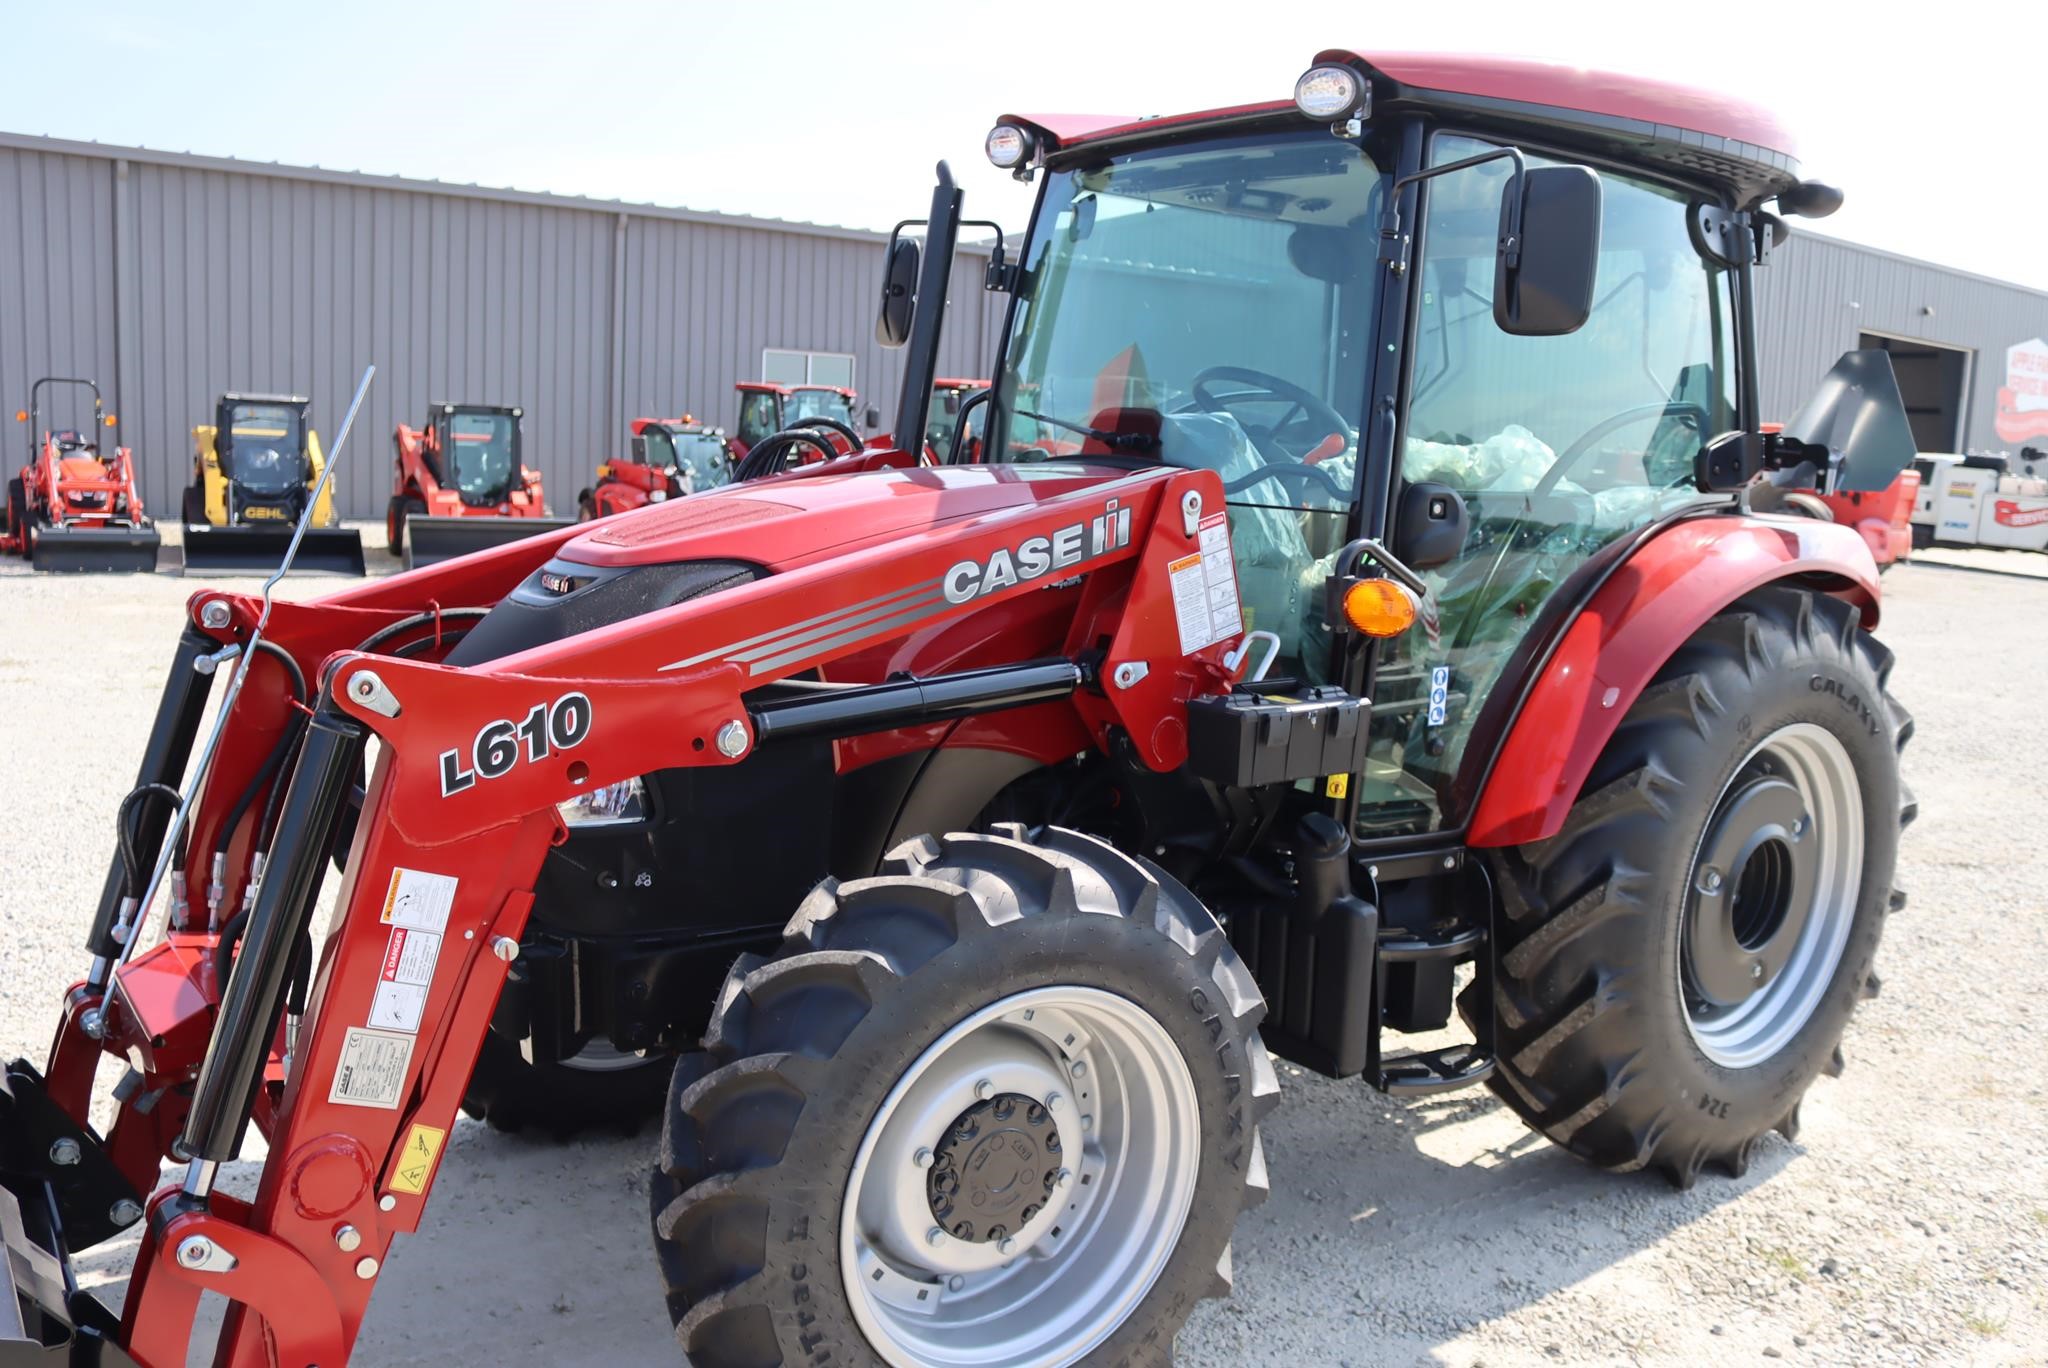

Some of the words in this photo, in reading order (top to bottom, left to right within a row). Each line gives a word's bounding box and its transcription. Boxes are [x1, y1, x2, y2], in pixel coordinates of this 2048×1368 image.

[245, 506, 287, 520] GEHL
[943, 523, 1083, 604] CASE
[542, 574, 560, 591] CASE
[1808, 673, 1881, 736] GALAXY
[439, 691, 592, 798] L610
[388, 871, 402, 908] WARNING
[388, 931, 404, 968] DANGER
[339, 1073, 349, 1094] CASE
[1191, 986, 1243, 1171] GALAXY
[1698, 1093, 1731, 1119] 324
